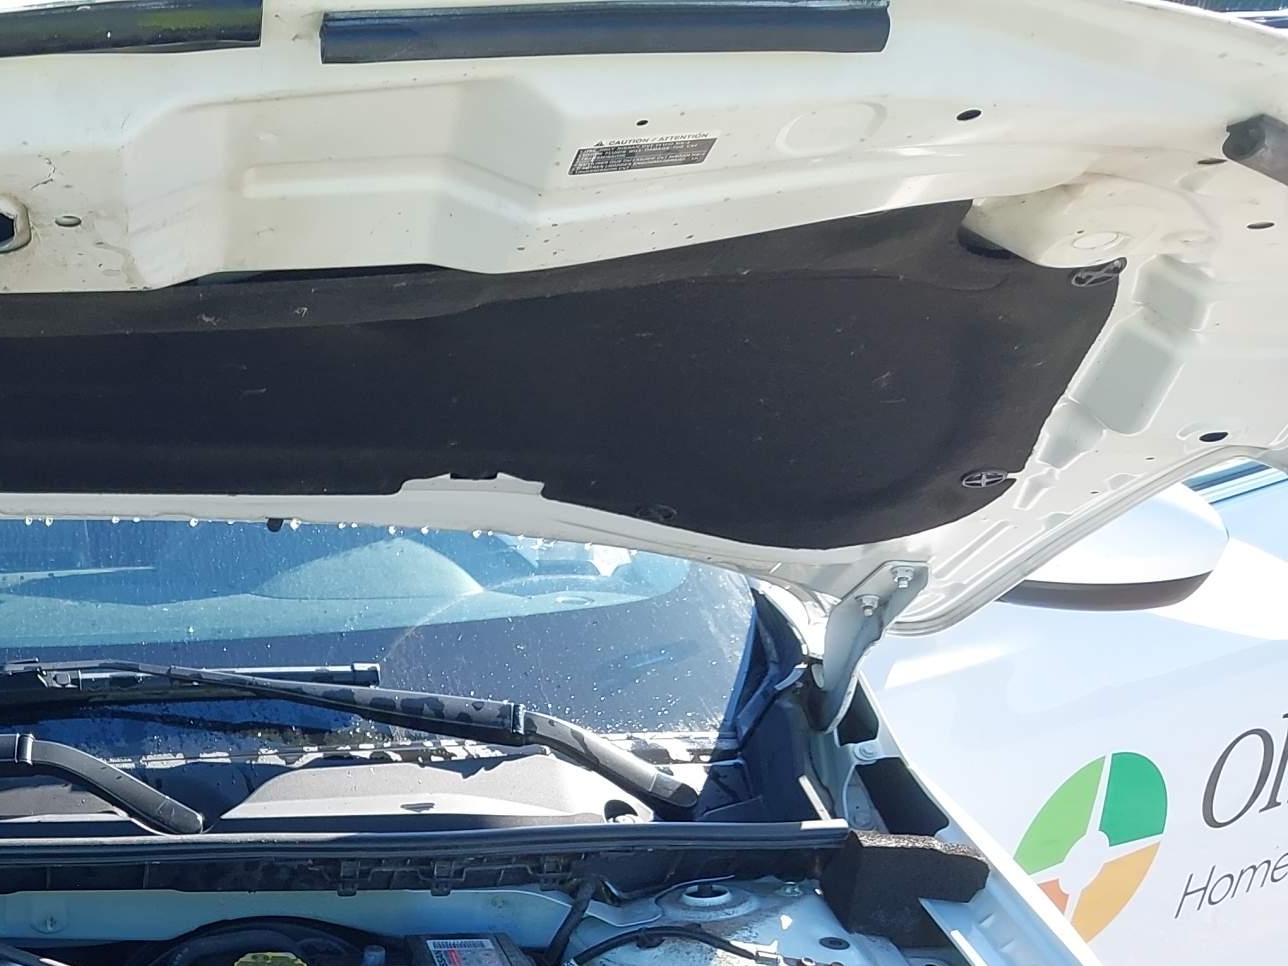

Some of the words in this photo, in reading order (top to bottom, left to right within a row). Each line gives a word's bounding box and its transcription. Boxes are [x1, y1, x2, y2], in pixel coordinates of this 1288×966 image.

[608, 137, 650, 146] CAUTION
[657, 132, 709, 142] ATTENTION
[1175, 852, 1288, 919] Home
